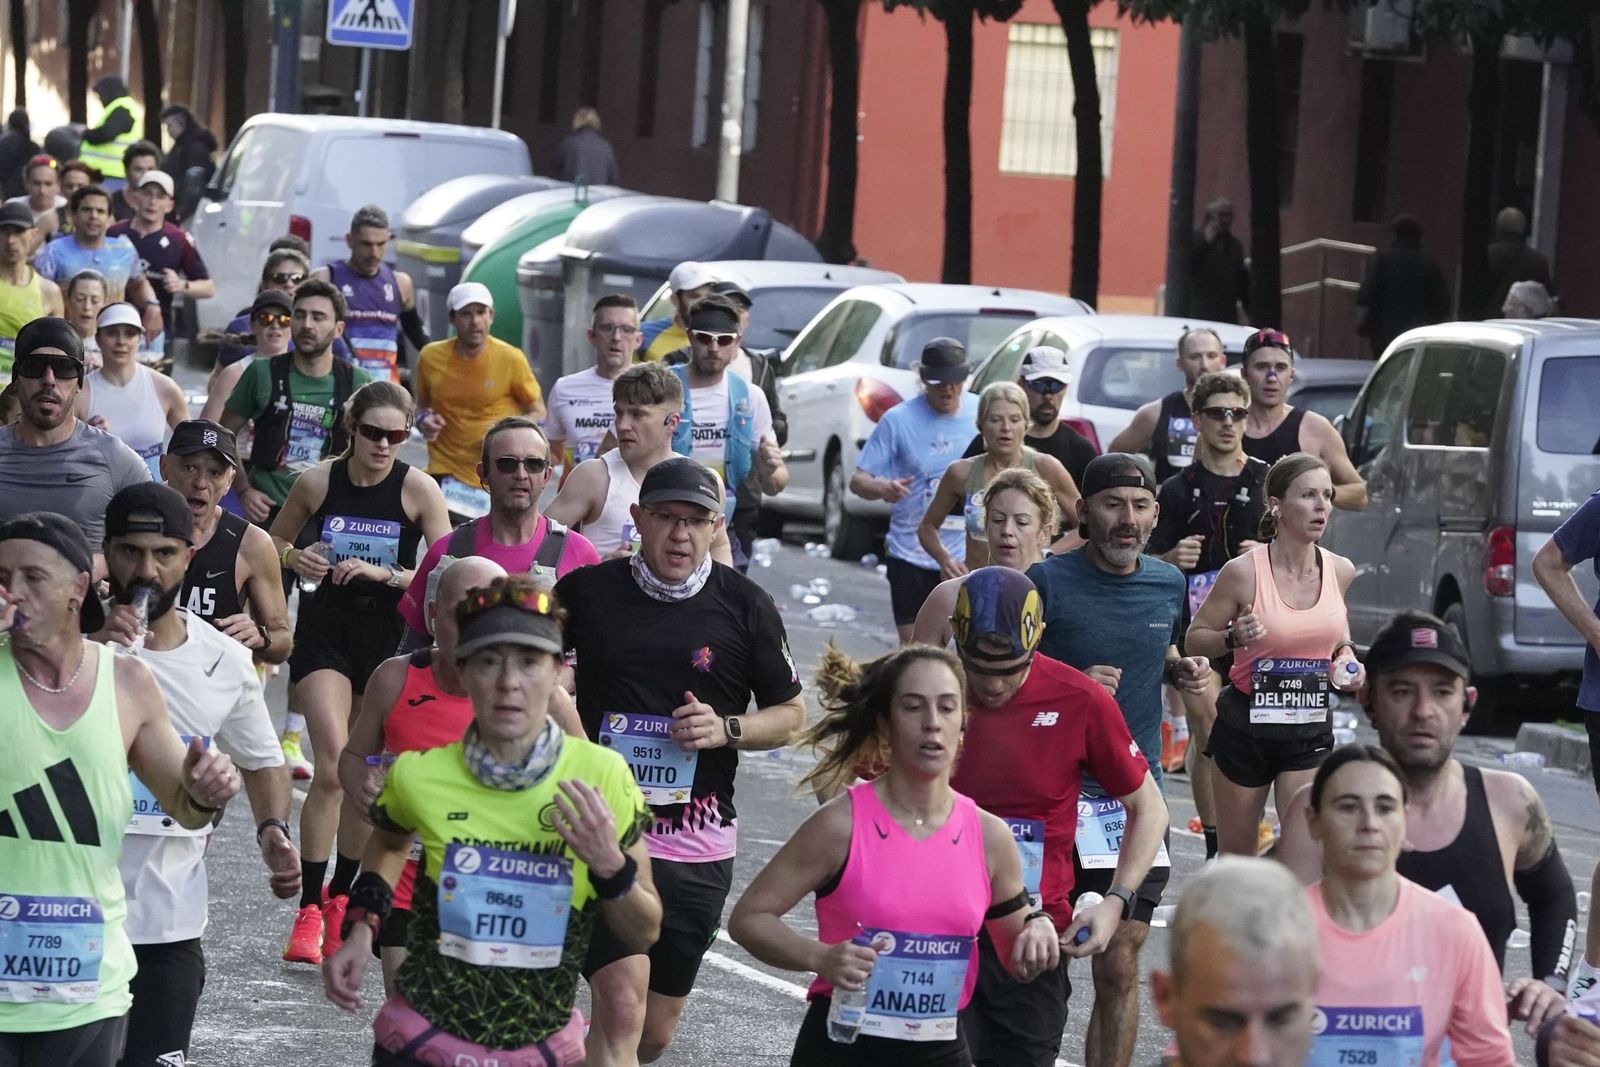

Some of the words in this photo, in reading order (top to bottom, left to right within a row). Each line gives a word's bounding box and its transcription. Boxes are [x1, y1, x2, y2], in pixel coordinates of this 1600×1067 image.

[349, 521, 391, 534] ZURICH
[348, 541, 370, 553] 7904
[1279, 660, 1320, 669] ZURICH
[1279, 680, 1303, 689] 4749
[1255, 692, 1325, 707] DELPHINE
[633, 719, 672, 734] ZURI
[633, 746, 662, 760] 9513
[1104, 819, 1126, 833] 636
[488, 856, 560, 879] ZURICH
[485, 891, 524, 909] 8645
[27, 902, 91, 918] ZURICH
[475, 913, 527, 939] FITO
[27, 934, 62, 949] 7789
[903, 939, 961, 955] ZURICH
[2, 954, 82, 978] XAVITO
[902, 970, 935, 986] 7144
[871, 989, 947, 1014] ANABEL
[1335, 1014, 1412, 1031] ZURICH
[1337, 1048, 1378, 1066] 7528
